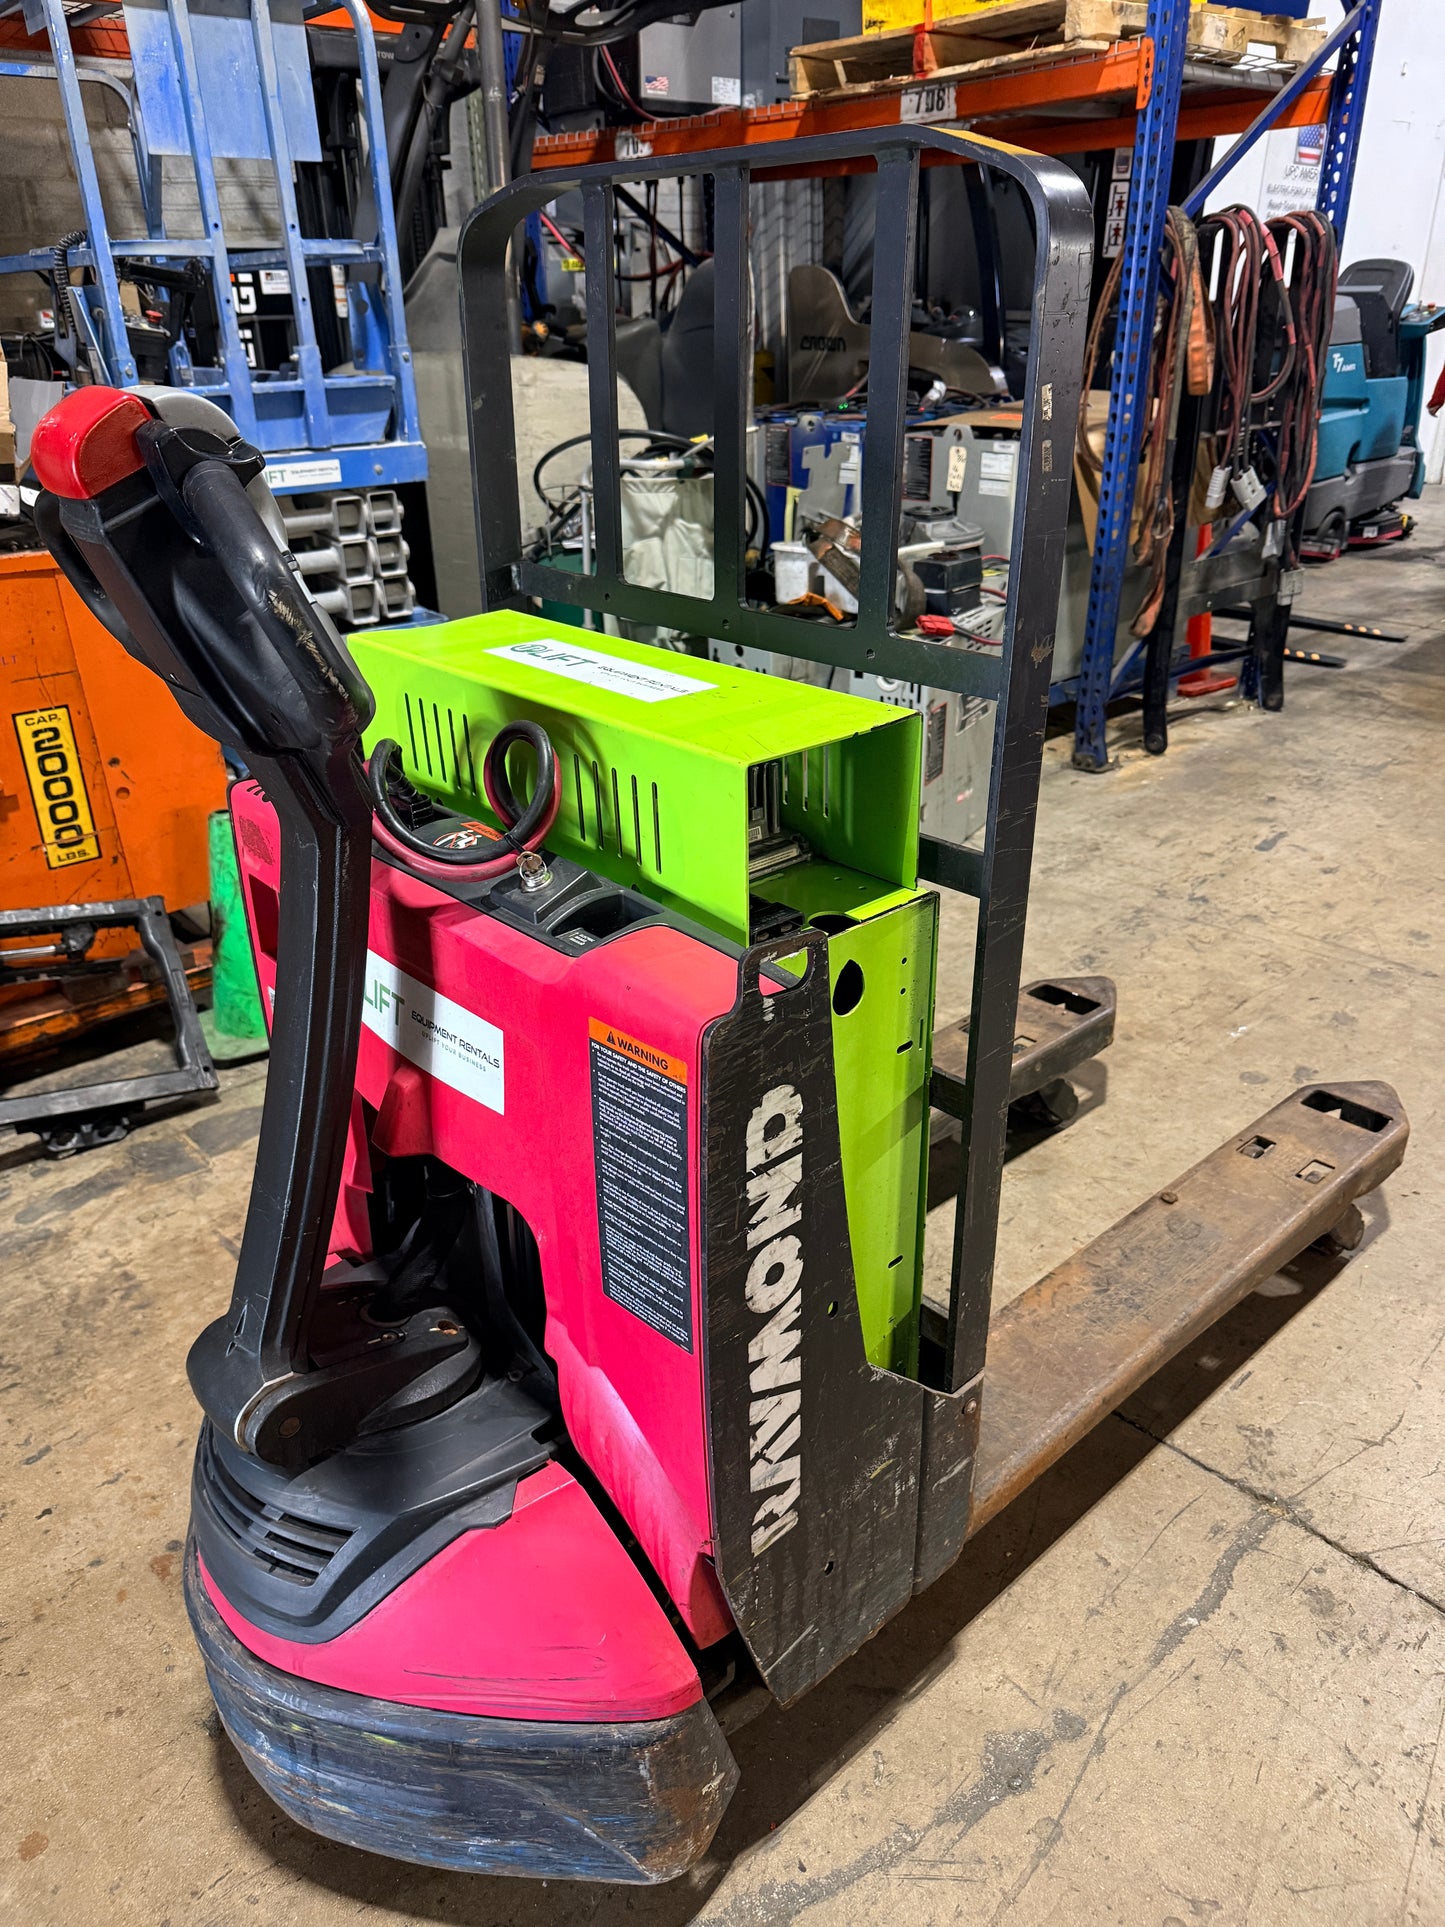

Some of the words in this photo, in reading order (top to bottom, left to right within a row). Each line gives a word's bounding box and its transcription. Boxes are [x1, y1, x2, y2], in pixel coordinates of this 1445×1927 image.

[24, 713, 62, 727] CAP.
[31, 726, 84, 849] 20000
[57, 848, 91, 862] LBS.
[411, 1010, 458, 1046] EQUIPMENT
[458, 1038, 500, 1069] RENTALS
[421, 1030, 440, 1046] UPLIFT
[441, 1042, 457, 1056] YOUR
[458, 1051, 487, 1072] BUSINESS
[617, 1036, 669, 1071] WARNING
[591, 1041, 601, 1051] FOR
[600, 1045, 612, 1056] YOUR
[612, 1051, 628, 1064] SAFETY
[627, 1059, 638, 1069] AND
[638, 1064, 646, 1074] THE
[646, 1069, 662, 1081] SAFETY
[661, 1077, 669, 1085] OF
[669, 1080, 686, 1094] OTHERS
[744, 1083, 804, 1558] RAYMOND
